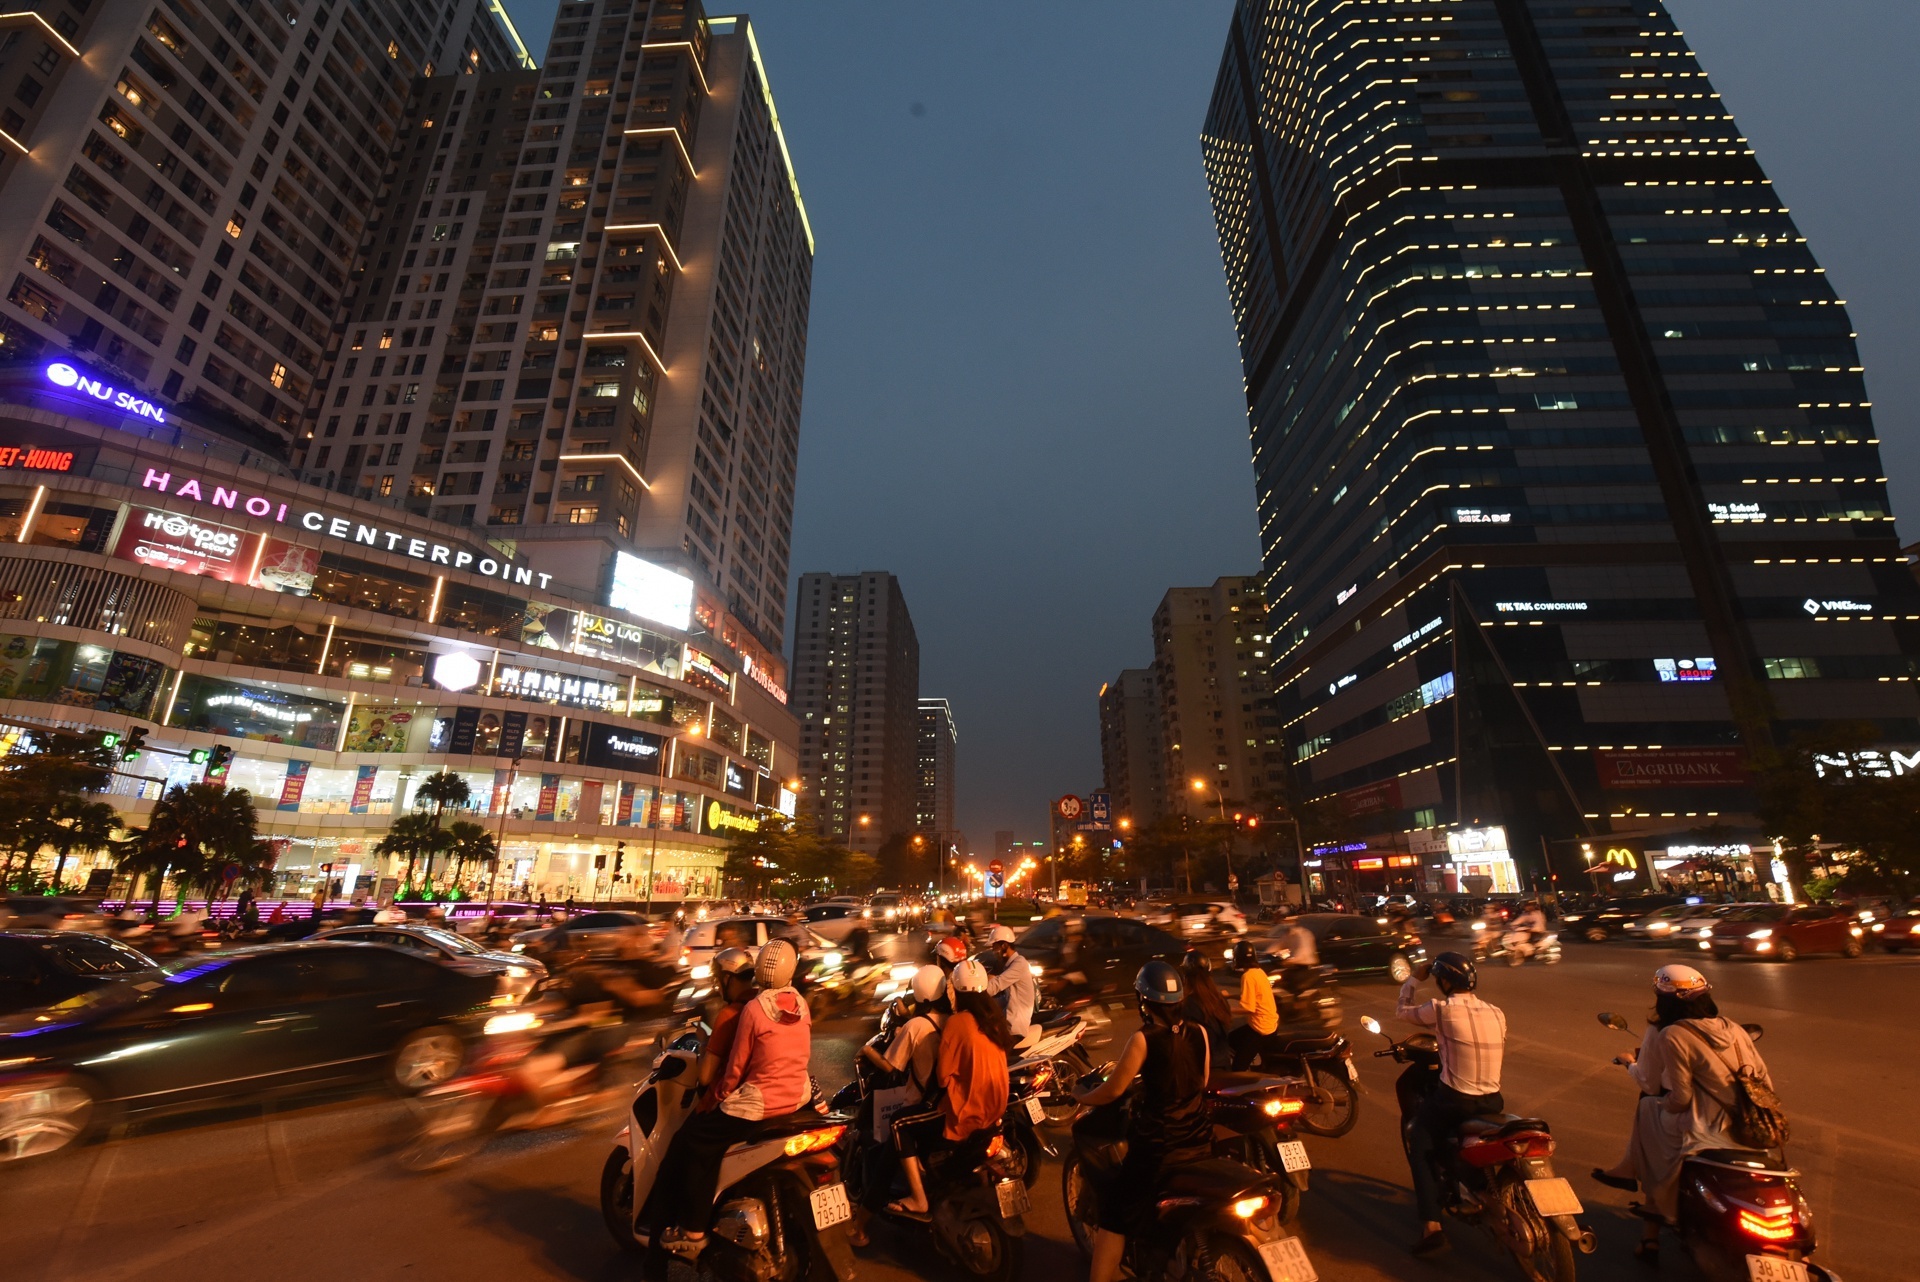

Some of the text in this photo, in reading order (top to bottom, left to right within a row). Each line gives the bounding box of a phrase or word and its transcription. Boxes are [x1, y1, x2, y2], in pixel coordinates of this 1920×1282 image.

[77, 376, 112, 400] NU
[1459, 514, 1511, 522] MIKADO
[142, 468, 553, 591] HANOI CENTERPOINT
[144, 512, 238, 547] Hotpot
[201, 542, 236, 556] story
[1513, 602, 1533, 611] TAK
[1534, 602, 1588, 610] COWORKING
[617, 627, 641, 643] LAO
[502, 668, 618, 700] MANWAH
[1660, 670, 1678, 681] DL
[750, 664, 768, 689] SCOTS
[768, 679, 787, 705] ENGLISH
[500, 685, 568, 702] TAIWANESE
[614, 740, 654, 755] IVYPREP
[1636, 763, 1722, 775] AGRIBANK
[1282, 1143, 1302, 1157] 29-E1
[816, 1187, 843, 1209] 29-T1
[817, 1203, 848, 1227] 795.22
[1755, 1259, 1798, 1281] 38-01
